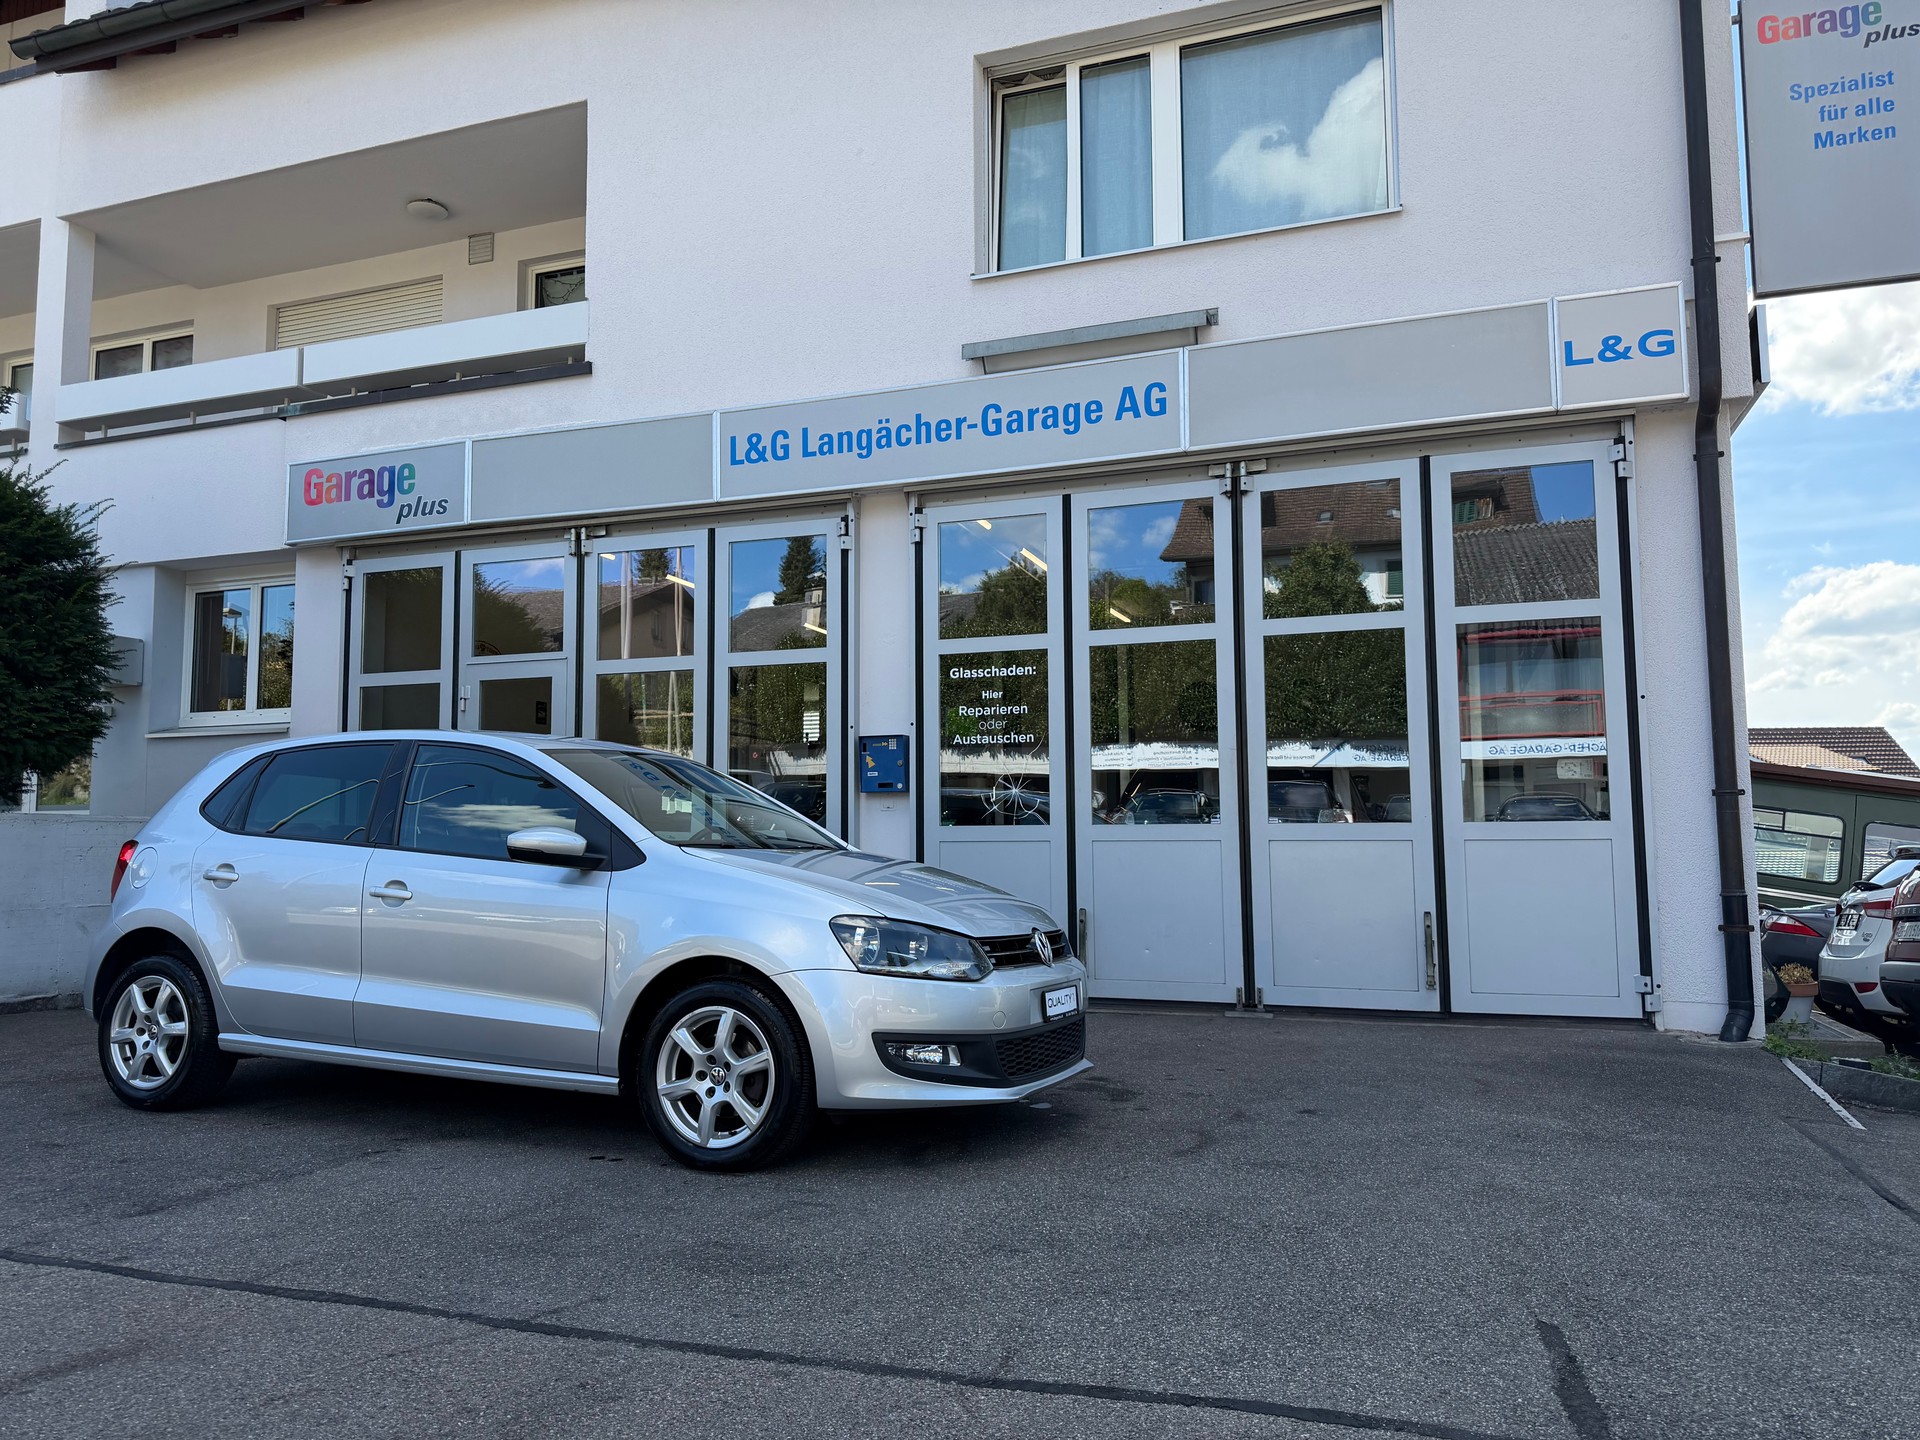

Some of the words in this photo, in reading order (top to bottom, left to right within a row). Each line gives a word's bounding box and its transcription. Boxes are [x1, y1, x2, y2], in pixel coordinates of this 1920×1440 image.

[1757, 1, 1882, 45] Garage
[1863, 23, 1920, 48] plus
[1789, 70, 1895, 103] Spezialist
[1818, 104, 1848, 122] für
[1854, 97, 1895, 117] alle
[1813, 125, 1897, 149] Marken
[1564, 329, 1675, 367] L&G
[729, 430, 790, 466] L&G
[801, 399, 1103, 459] Langächer-Garage
[1114, 382, 1168, 421] AG
[303, 463, 416, 508] Garage
[395, 495, 449, 524] plus
[949, 665, 1037, 679] Glasschaden:
[981, 690, 1004, 700] Hier
[958, 705, 1028, 717] Reparieren
[978, 718, 1008, 730] oder
[952, 732, 1034, 745] Austauschen
